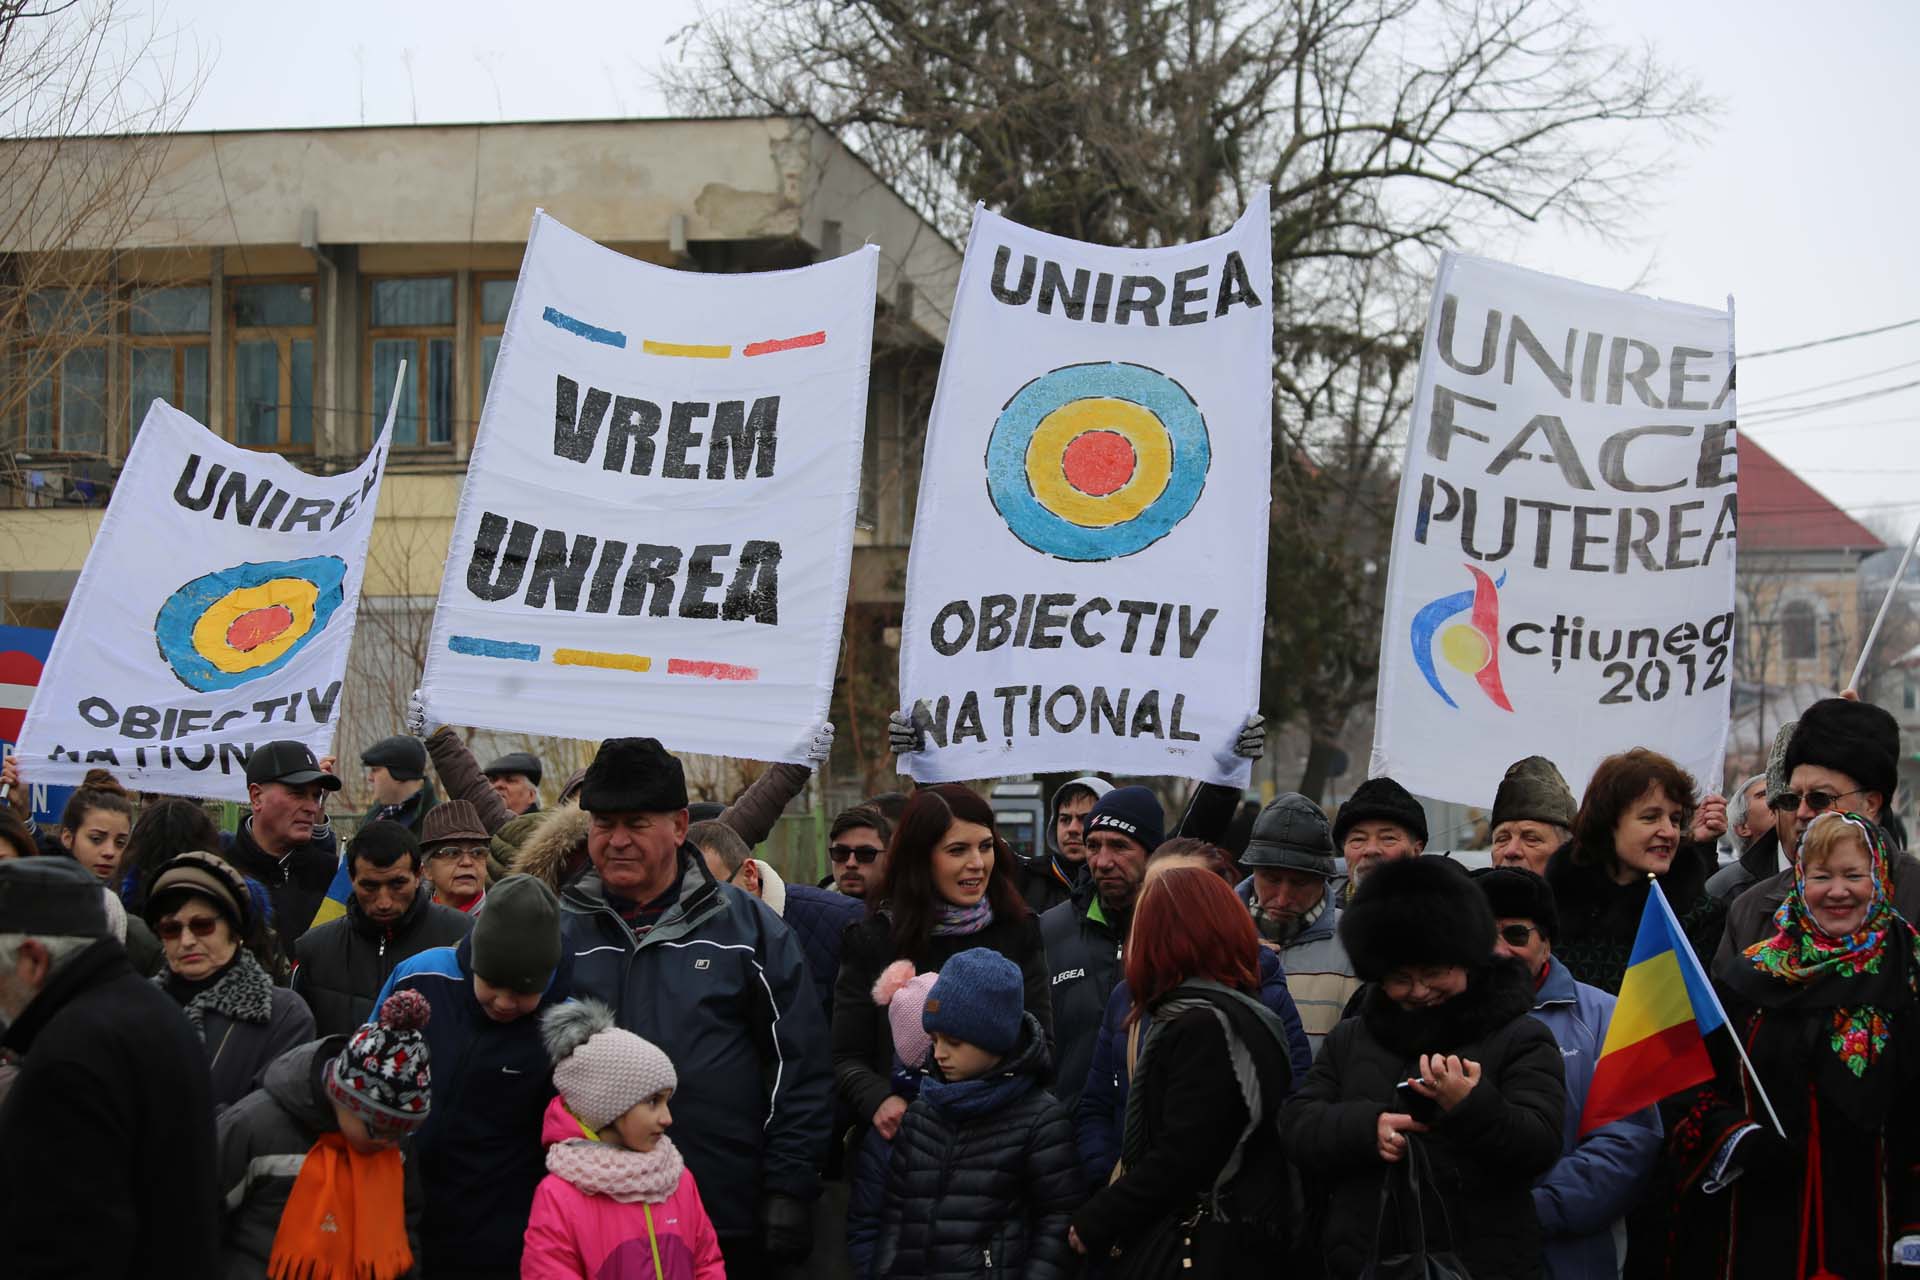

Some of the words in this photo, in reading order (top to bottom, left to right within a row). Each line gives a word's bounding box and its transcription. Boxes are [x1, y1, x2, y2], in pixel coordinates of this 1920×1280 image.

[991, 245, 1262, 327] UNIREA
[554, 374, 780, 480] VREM
[1427, 384, 1738, 493] FACE
[1415, 473, 1738, 574] PUTEREA
[466, 511, 782, 626] UNIREA
[931, 593, 1218, 659] OBIECTIV
[78, 681, 342, 741] OBIECTIV
[1599, 646, 1728, 704] 2012
[1099, 815, 1137, 833] Zeus
[1052, 967, 1085, 985] LEGEA
